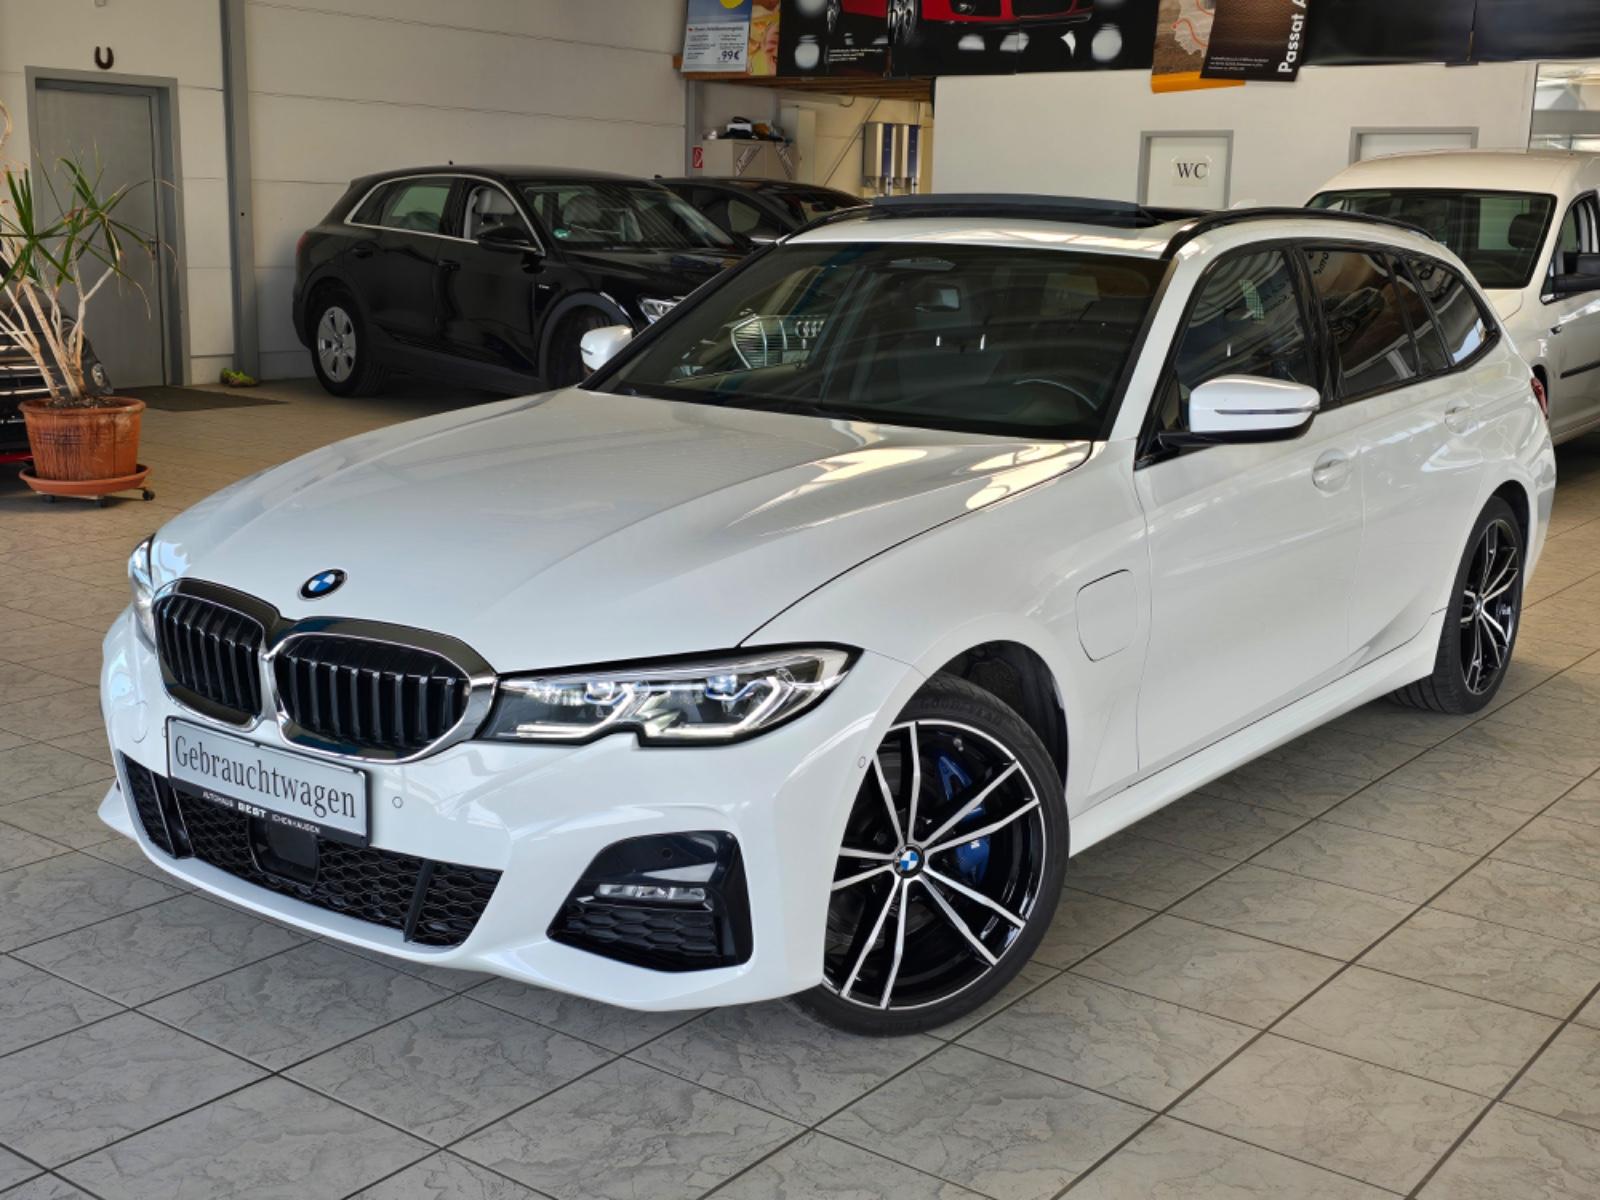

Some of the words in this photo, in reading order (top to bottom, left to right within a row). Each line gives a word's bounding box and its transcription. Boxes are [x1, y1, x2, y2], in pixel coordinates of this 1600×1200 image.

[1277, 13, 1305, 73] Passat
[1176, 162, 1208, 180] WC
[174, 735, 356, 818] Gebrauchtwagen
[237, 801, 268, 818] BEST
